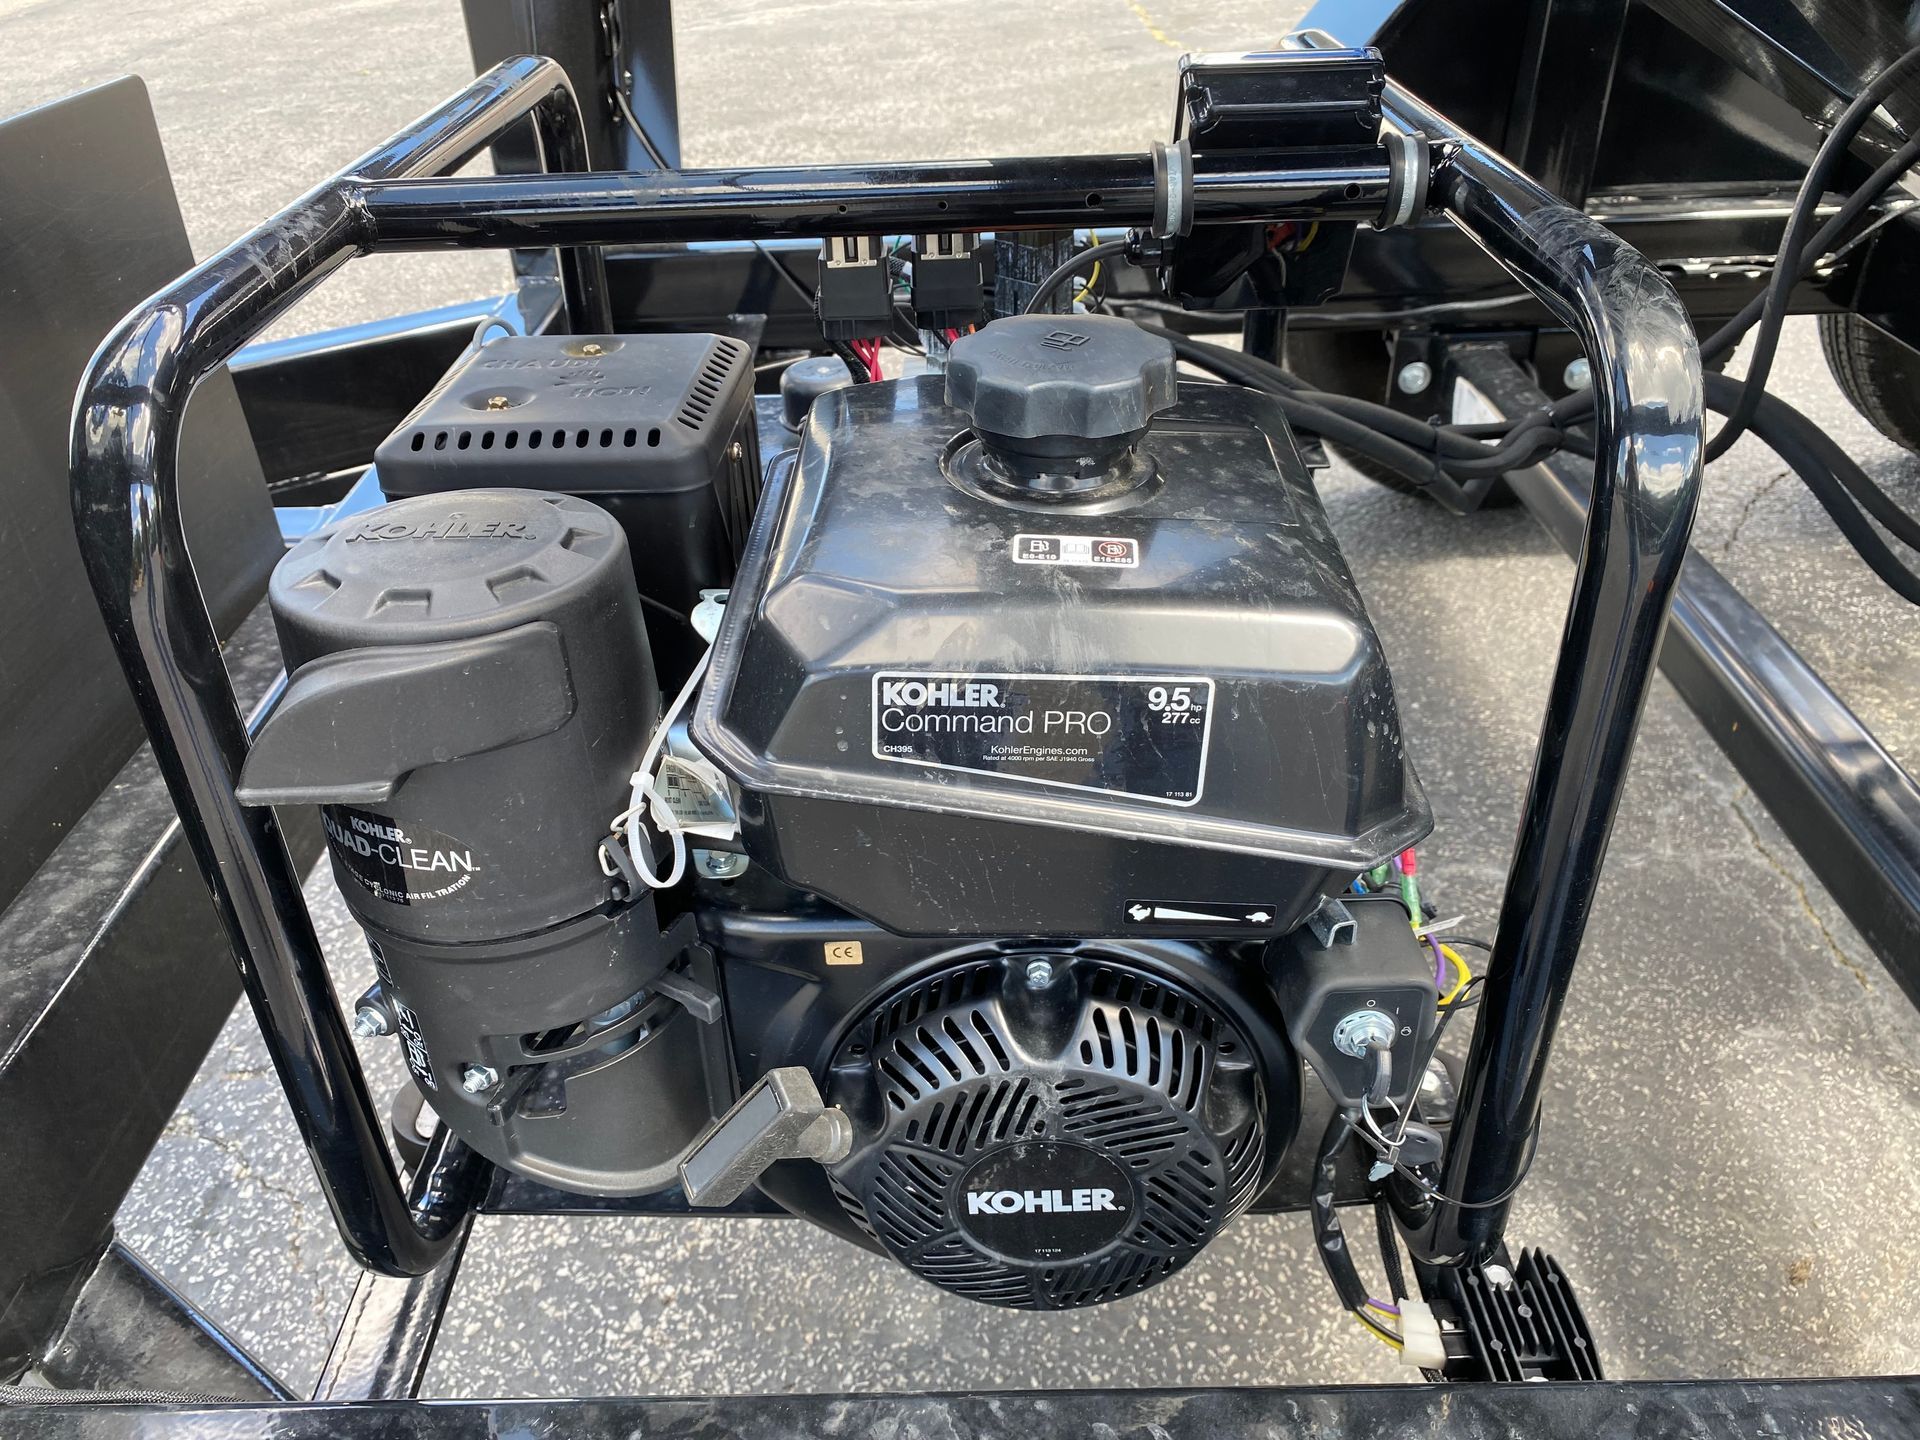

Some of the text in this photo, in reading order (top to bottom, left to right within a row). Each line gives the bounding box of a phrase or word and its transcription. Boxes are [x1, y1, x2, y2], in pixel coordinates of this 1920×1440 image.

[882, 681, 1000, 708] KOHLER
[1148, 686, 1191, 712] 9.5
[881, 707, 1112, 735] Command PRO
[1161, 712, 1190, 724] 277
[883, 745, 913, 753] CH395
[990, 745, 1088, 756] KohlerEngines.com
[406, 892, 421, 900] AIR
[832, 946, 854, 959] CE
[967, 1188, 1118, 1215] KOHLER
